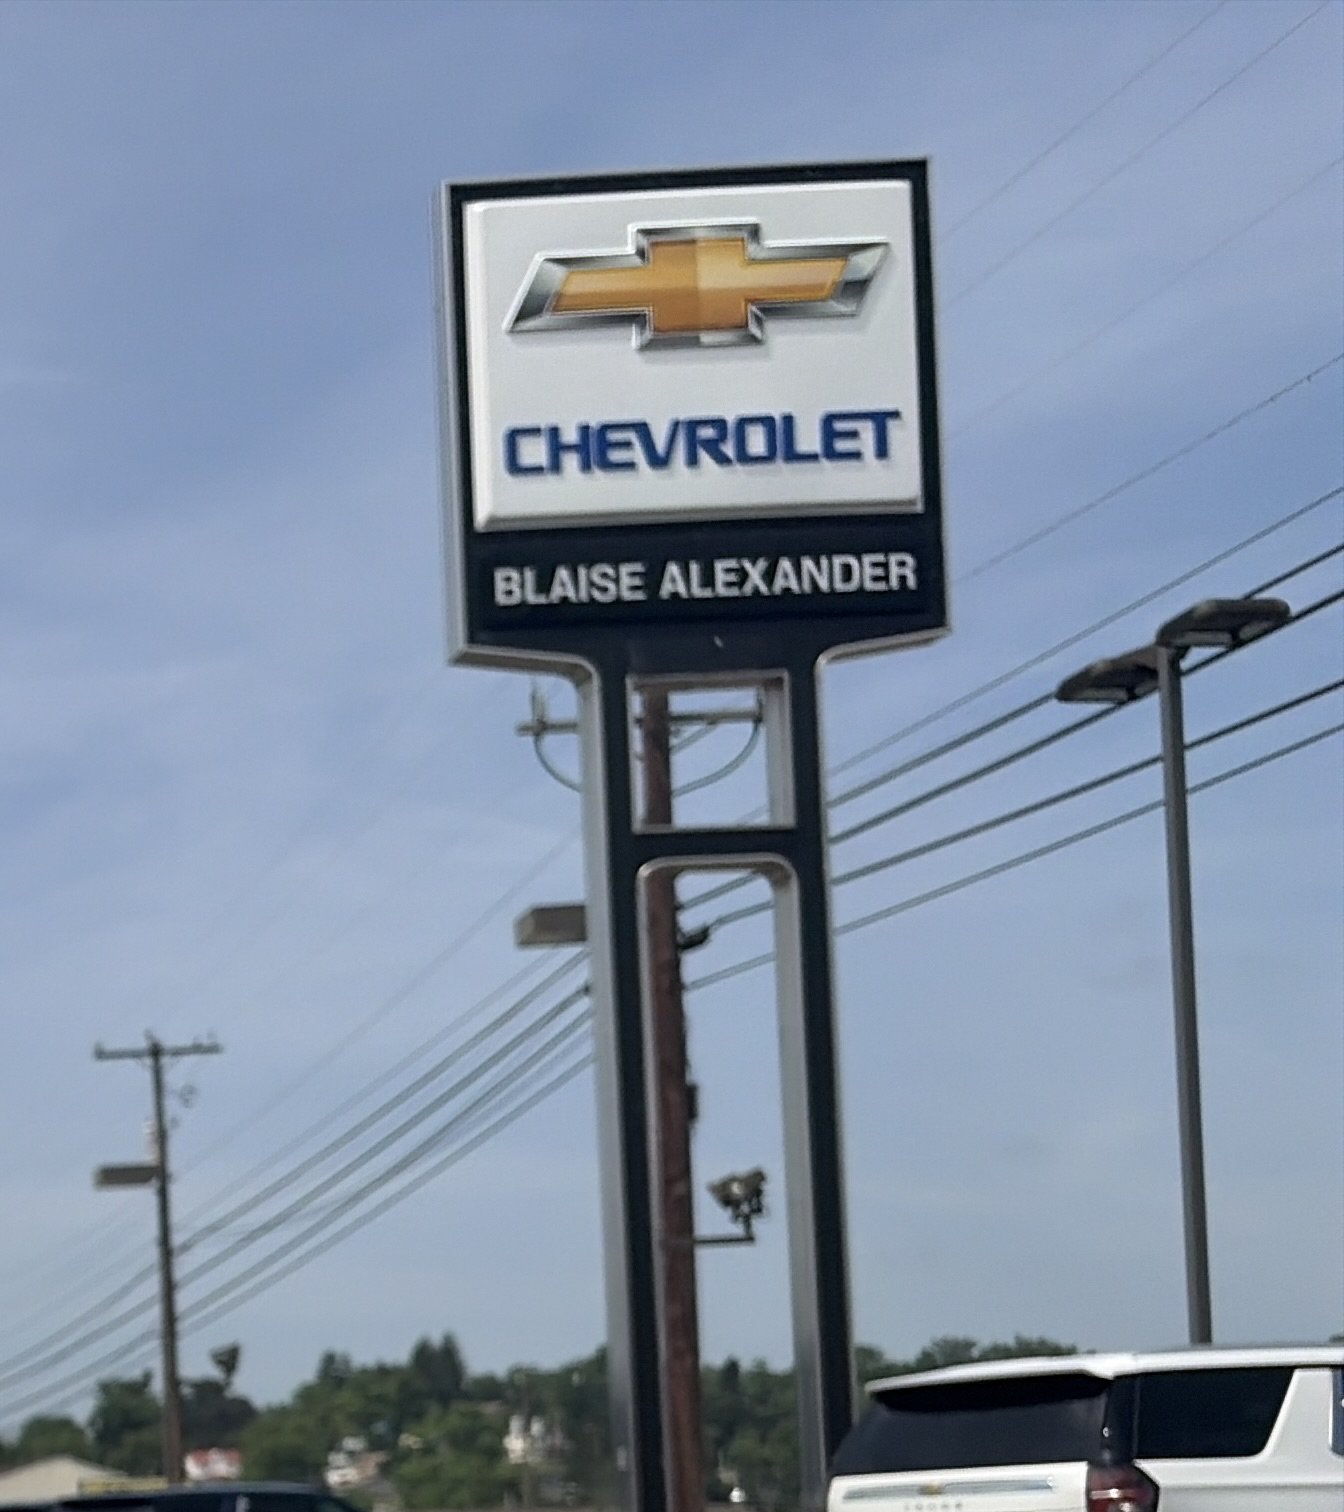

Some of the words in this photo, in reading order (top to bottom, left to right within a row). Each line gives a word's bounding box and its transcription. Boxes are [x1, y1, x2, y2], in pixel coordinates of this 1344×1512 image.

[503, 408, 902, 478] CHEVROLET
[493, 559, 647, 607] BLAISE
[658, 551, 919, 601] ALEXANDER
